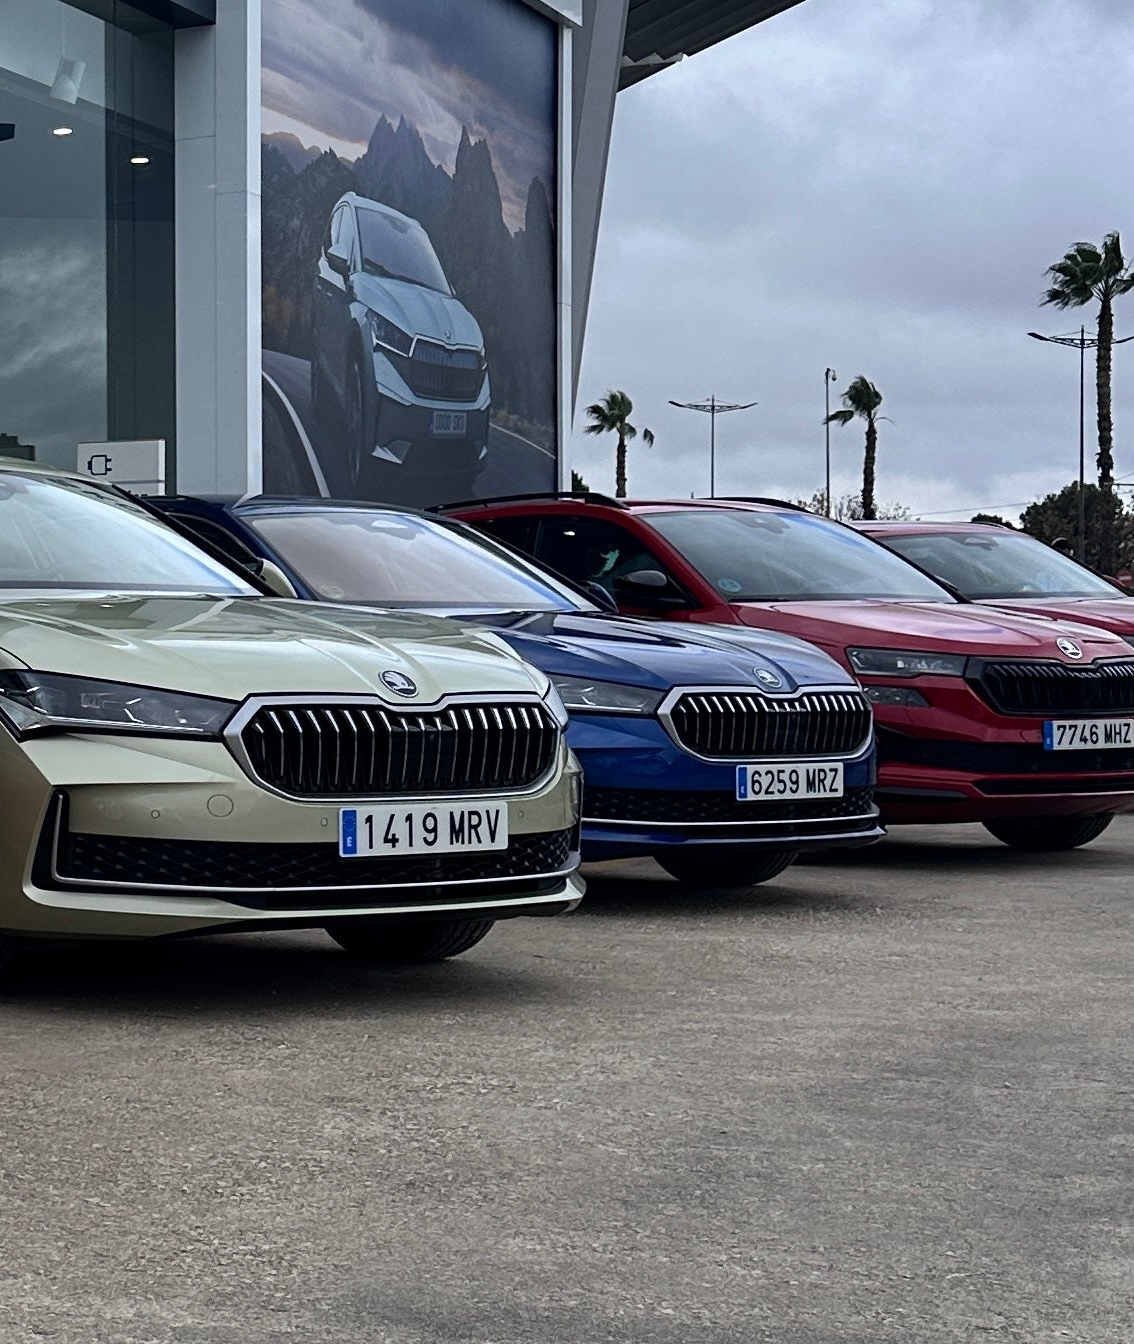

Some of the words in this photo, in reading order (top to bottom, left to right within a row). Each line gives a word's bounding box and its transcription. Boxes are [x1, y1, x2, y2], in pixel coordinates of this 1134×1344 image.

[1056, 724, 1099, 746] 7746
[1104, 722, 1132, 745] MHZ
[751, 769, 800, 796] 6259
[806, 767, 839, 794] MRZ
[364, 812, 438, 850] 1419
[449, 809, 500, 846] MRV
